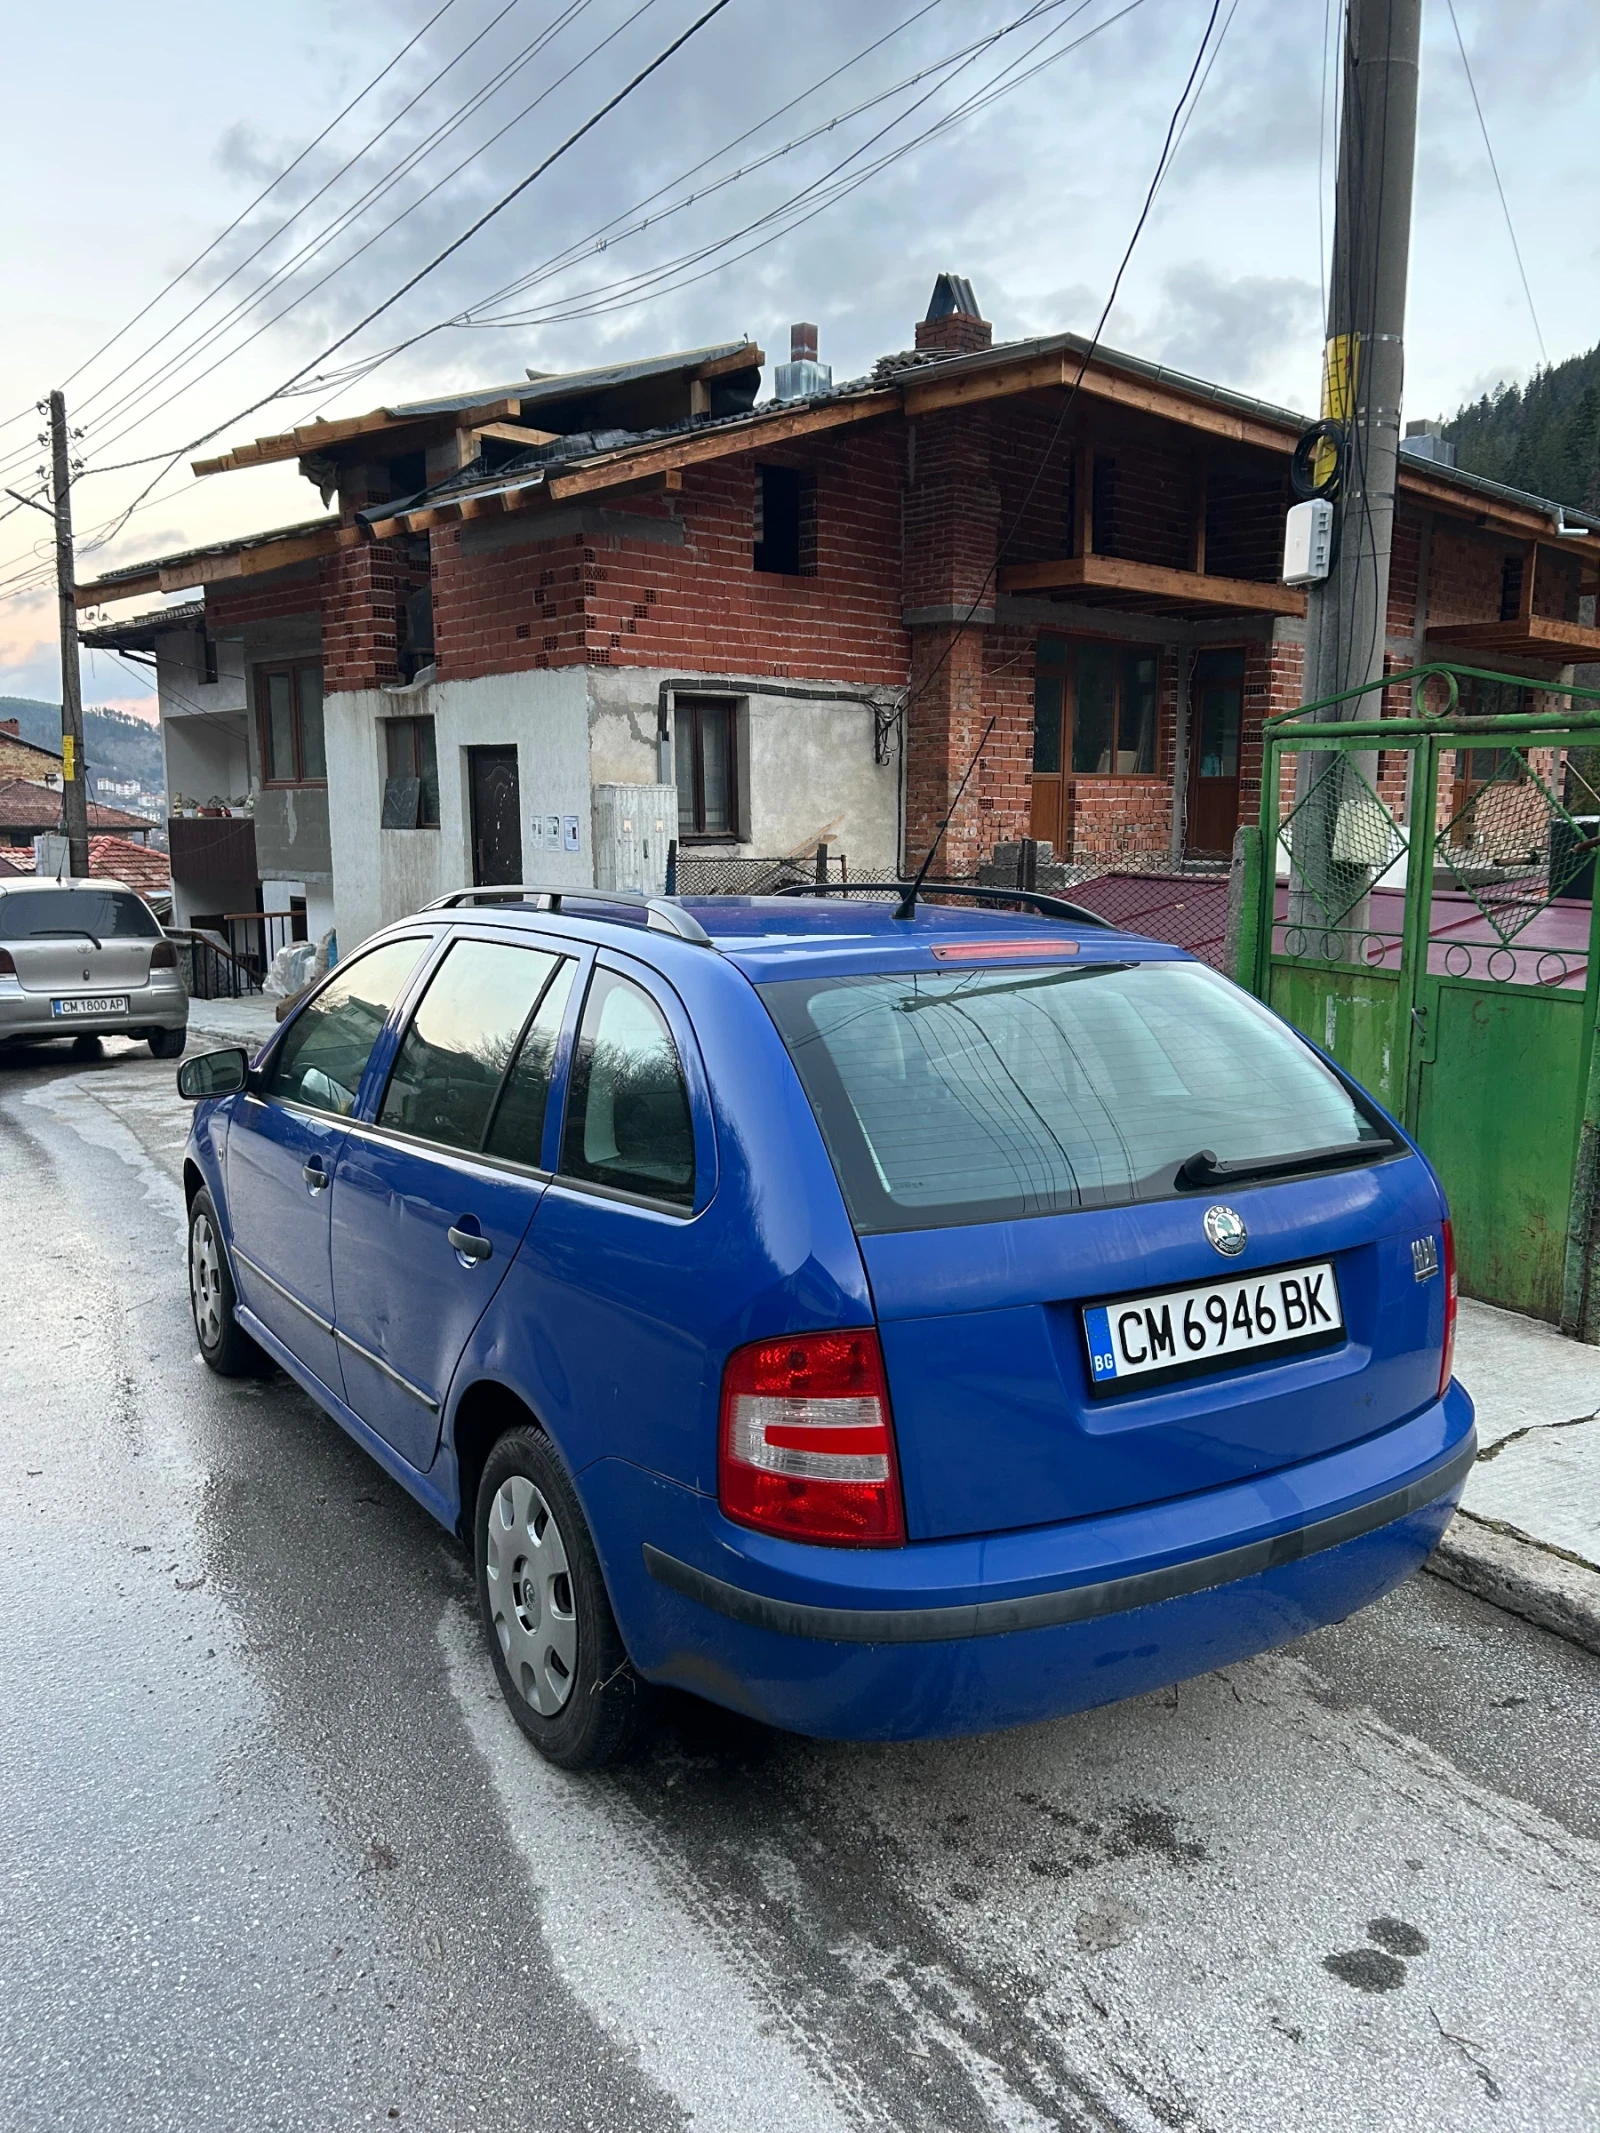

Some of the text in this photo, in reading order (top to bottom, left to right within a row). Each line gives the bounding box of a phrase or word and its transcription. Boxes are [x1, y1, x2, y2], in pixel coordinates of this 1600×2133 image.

[62, 999, 124, 1013] CM 1800 AP
[1118, 1273, 1332, 1365] CM 6946 BK
[1094, 1353, 1114, 1372] BG
